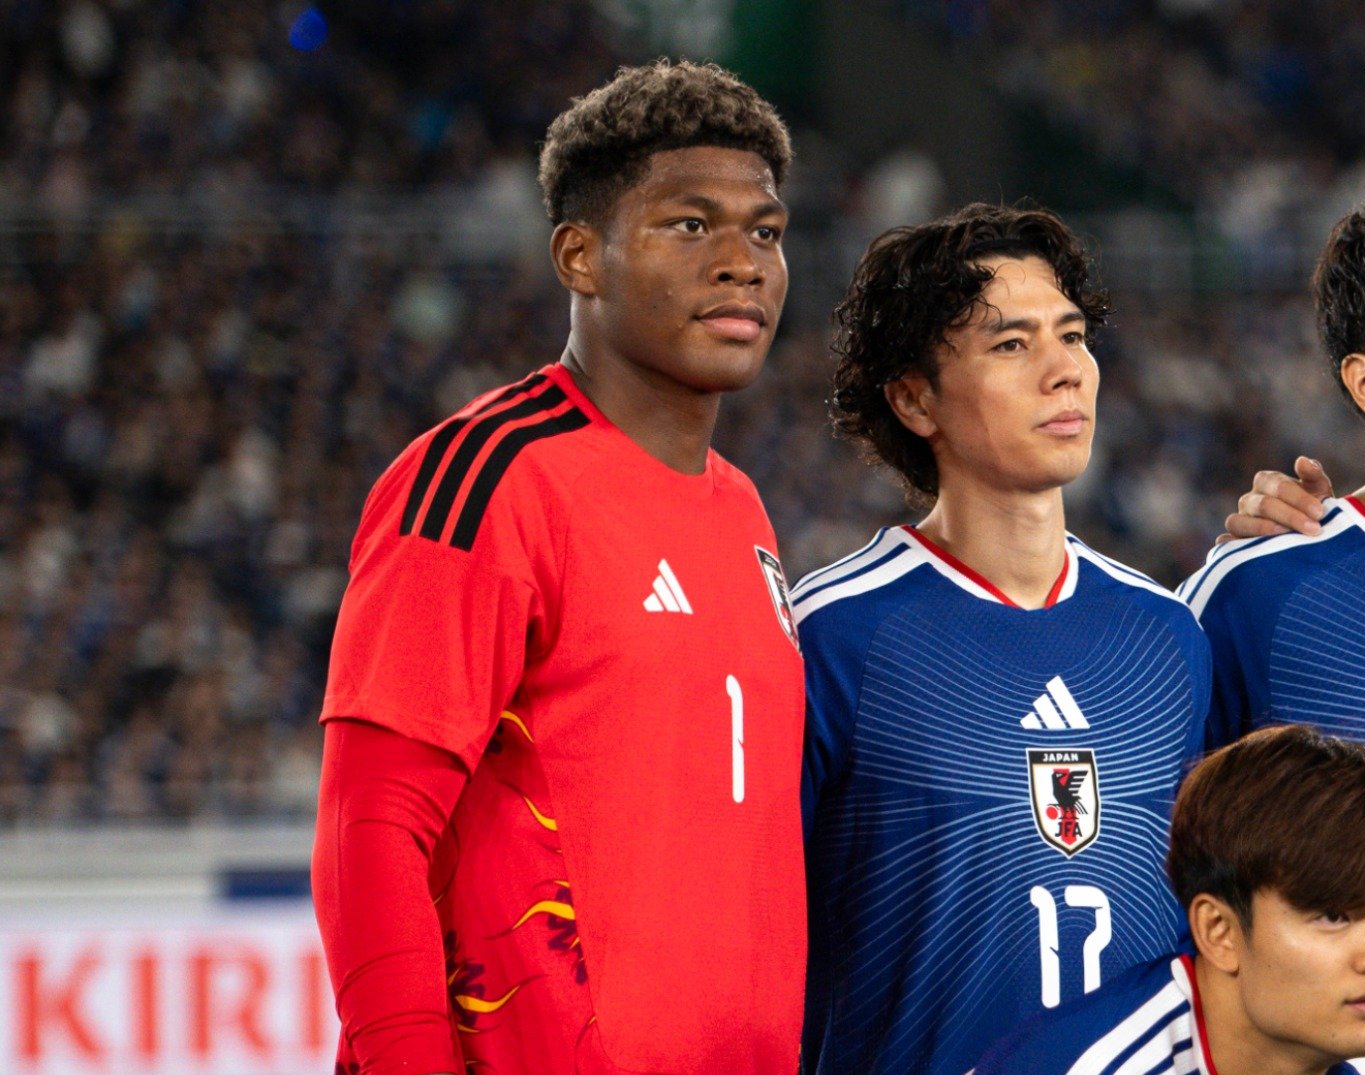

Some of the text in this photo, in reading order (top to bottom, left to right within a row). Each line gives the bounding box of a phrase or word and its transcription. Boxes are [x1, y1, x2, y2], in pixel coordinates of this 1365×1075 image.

[727, 674, 744, 803] 1
[1042, 753, 1080, 763] JAPAN
[1054, 821, 1083, 839] JFA
[1029, 885, 1112, 1008] 17
[12, 950, 328, 1062] KIRI
